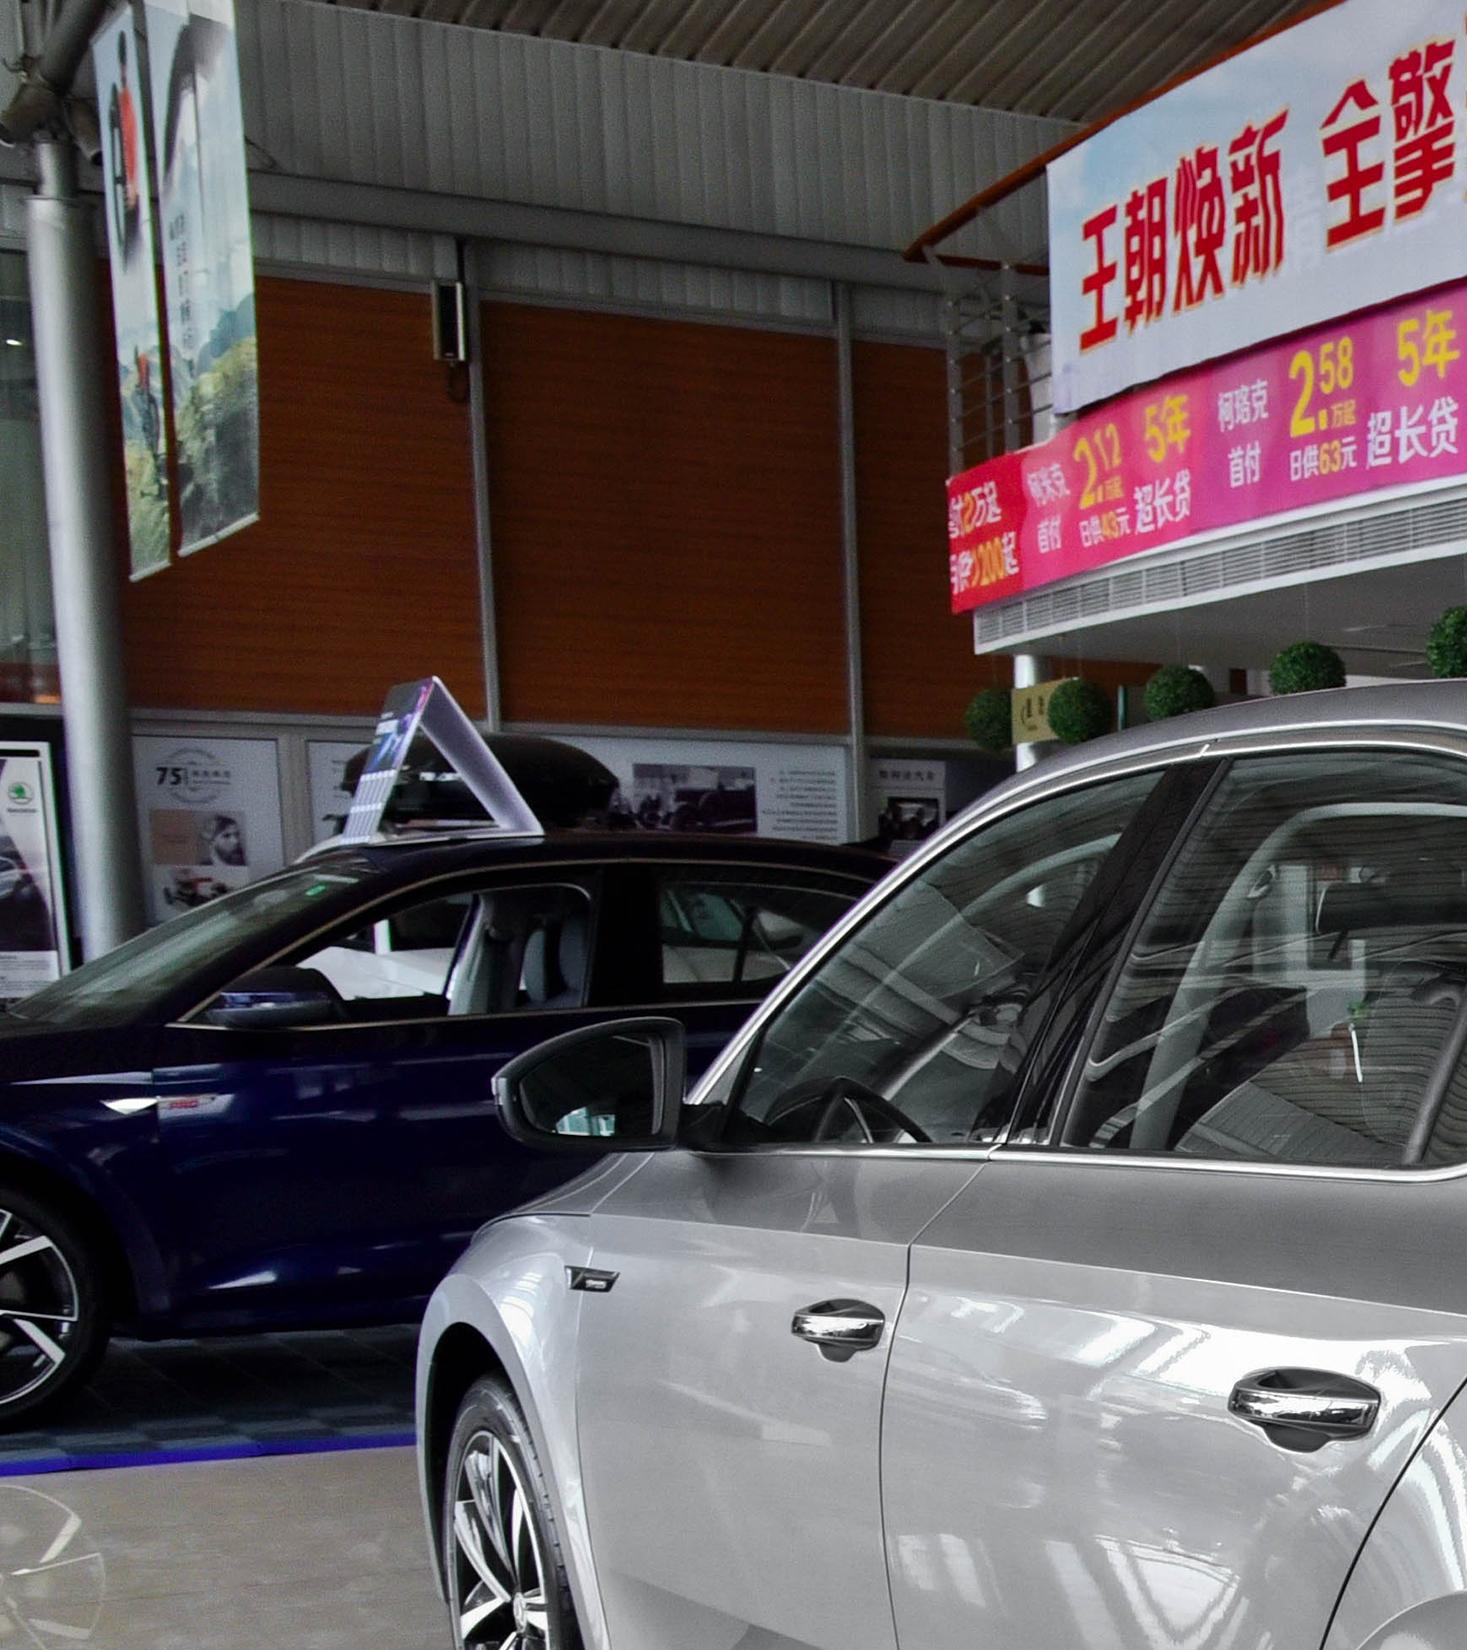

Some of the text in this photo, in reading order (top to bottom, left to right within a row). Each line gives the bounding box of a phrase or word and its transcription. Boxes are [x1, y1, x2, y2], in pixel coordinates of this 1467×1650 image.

[1079, 108, 1289, 354] 王朝焕新
[1397, 310, 1460, 387] 5年
[1144, 394, 1191, 463] 5年
[1290, 436, 1357, 482] 日供63元
[1366, 396, 1459, 469] 超长贷
[1228, 441, 1262, 488] 首付
[1134, 469, 1191, 535] 超长贷
